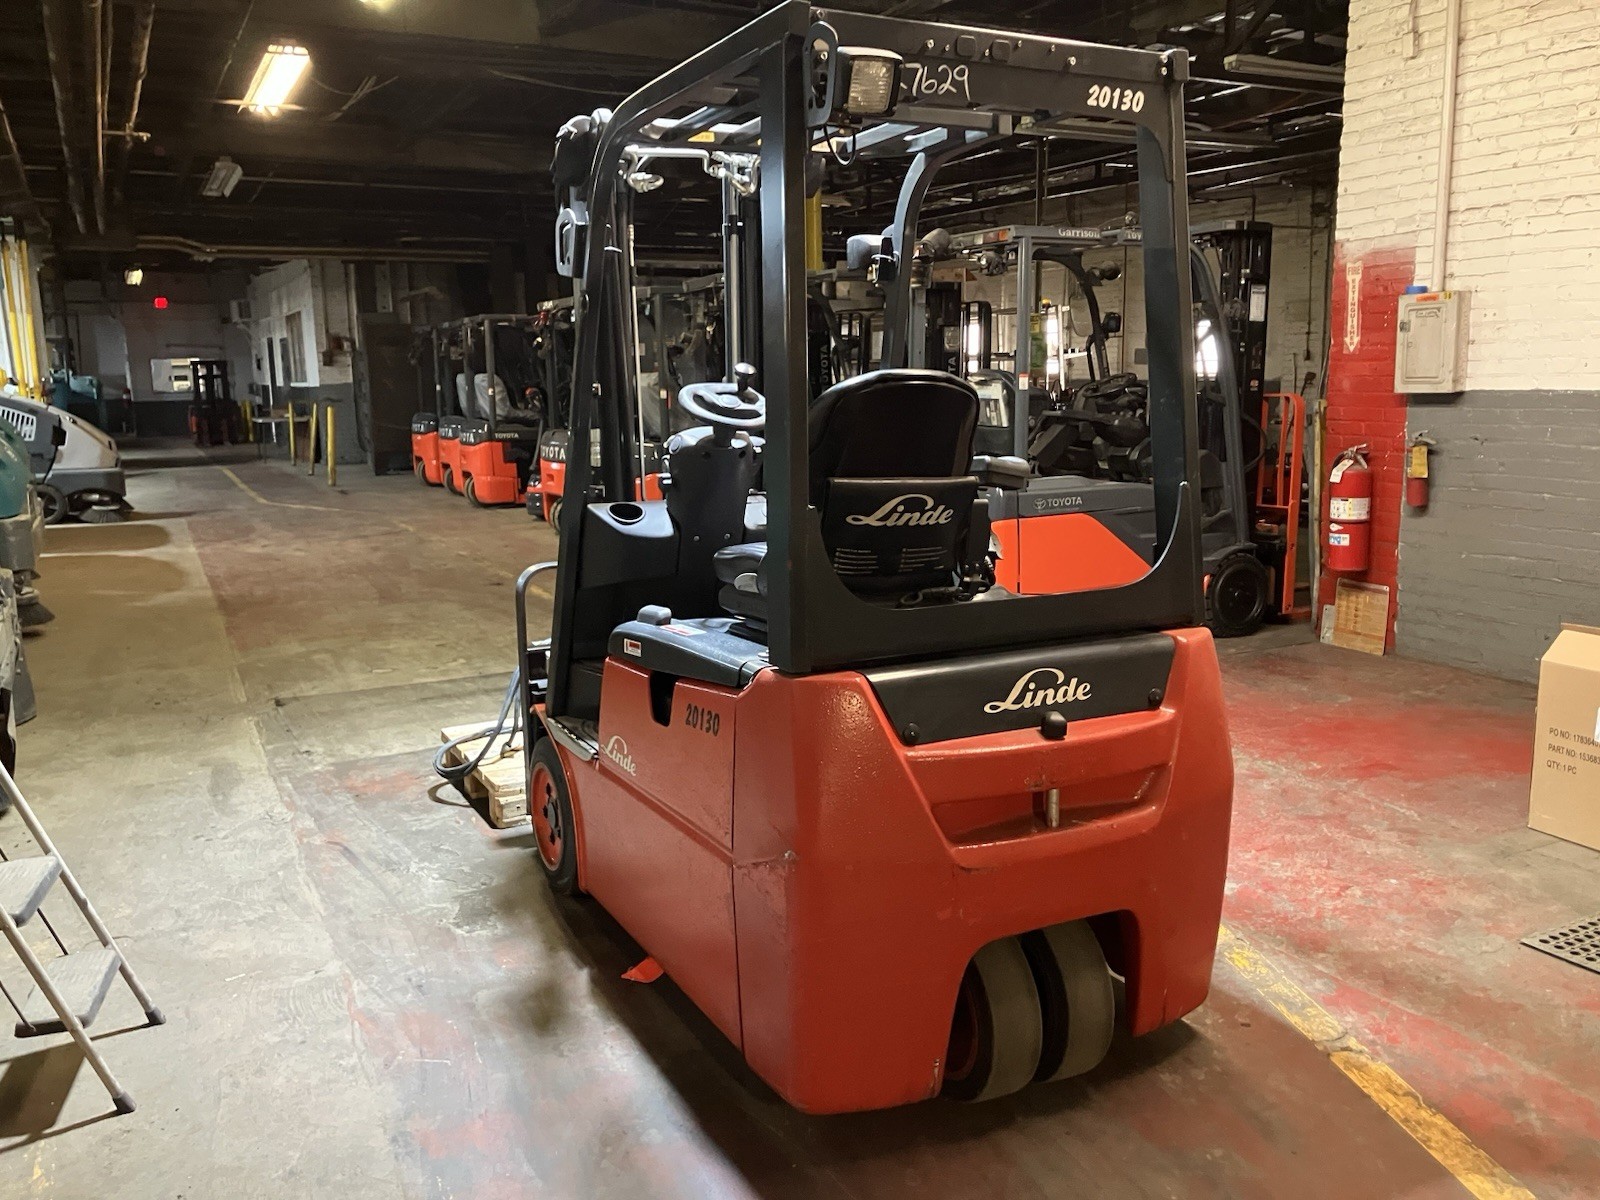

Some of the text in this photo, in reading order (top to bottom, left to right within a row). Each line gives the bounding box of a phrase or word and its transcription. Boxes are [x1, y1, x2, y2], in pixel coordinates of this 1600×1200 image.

[900, 62, 971, 101] 7629
[1086, 84, 1145, 113] 20130
[1347, 266, 1361, 276] FIRE
[845, 493, 954, 527] Linde
[1047, 496, 1083, 507] TOYOTA
[983, 667, 1092, 714] Linde
[685, 703, 720, 737] 20130
[1549, 728, 1559, 737] PO
[600, 735, 636, 777] Linde
[1548, 743, 1564, 754] PART
[1567, 765, 1577, 775] PC
